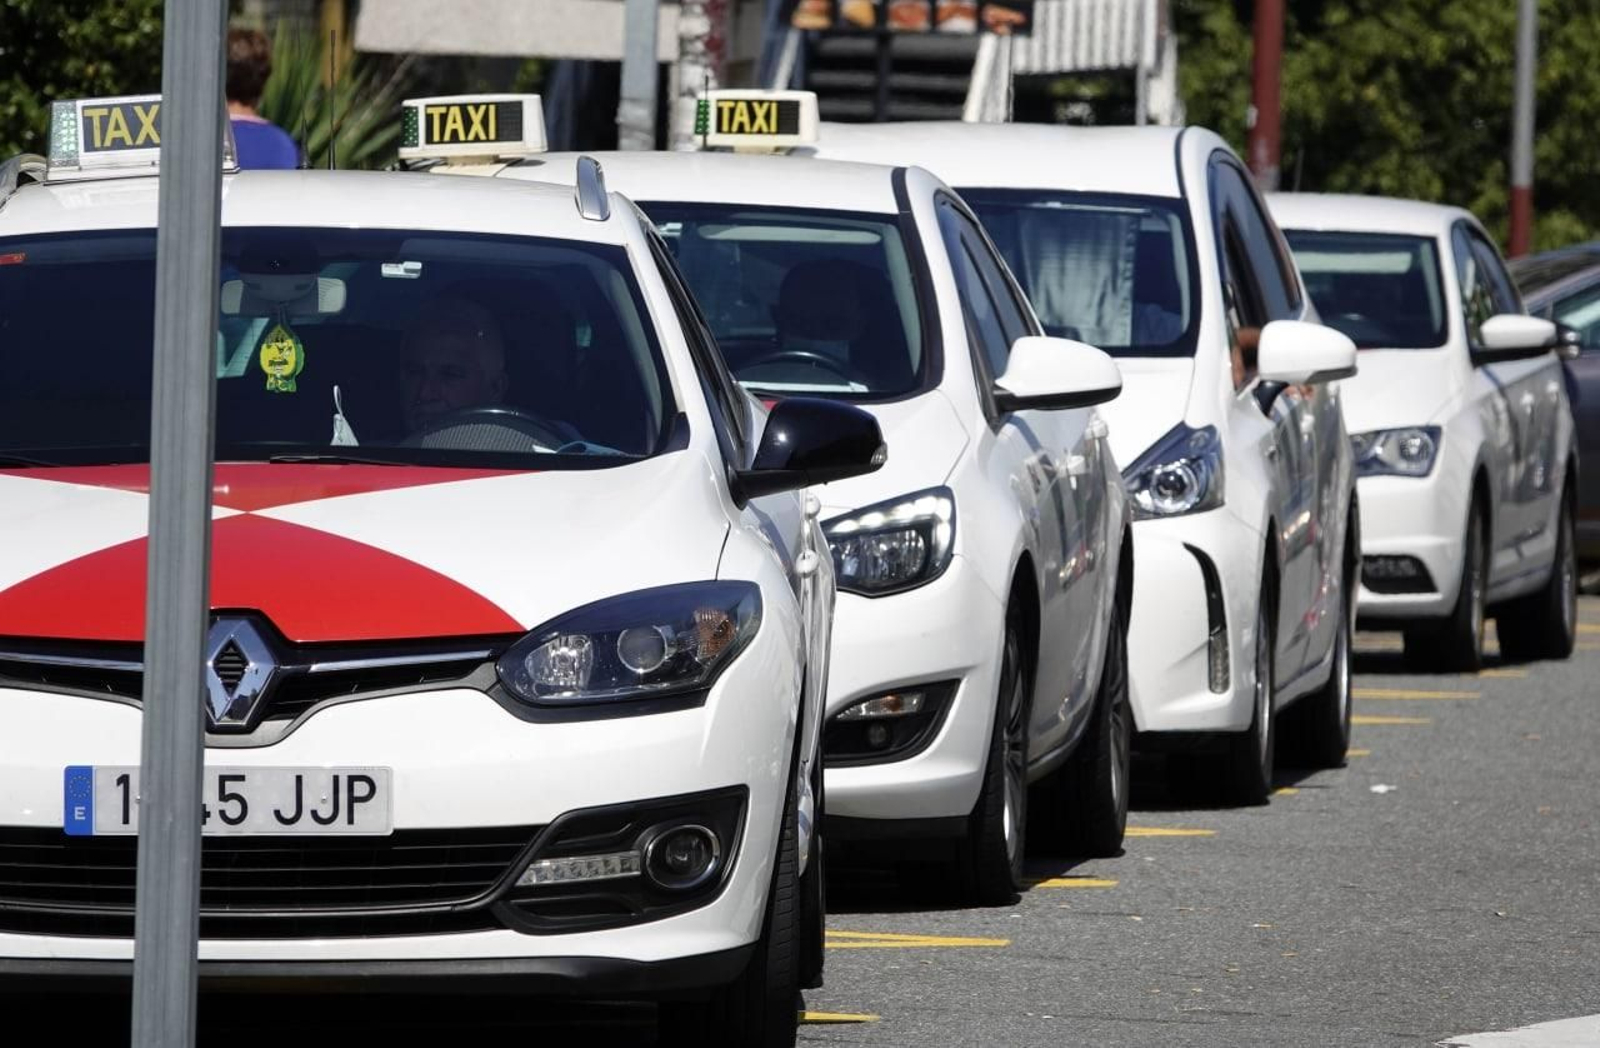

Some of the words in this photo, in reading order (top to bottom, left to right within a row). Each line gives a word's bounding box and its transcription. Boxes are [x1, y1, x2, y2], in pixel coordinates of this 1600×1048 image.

[83, 104, 161, 148] TAX
[426, 104, 497, 142] TAXI
[717, 101, 778, 133] TAXI
[74, 806, 86, 821] E
[116, 774, 248, 826] 15
[273, 774, 377, 826] JJP
